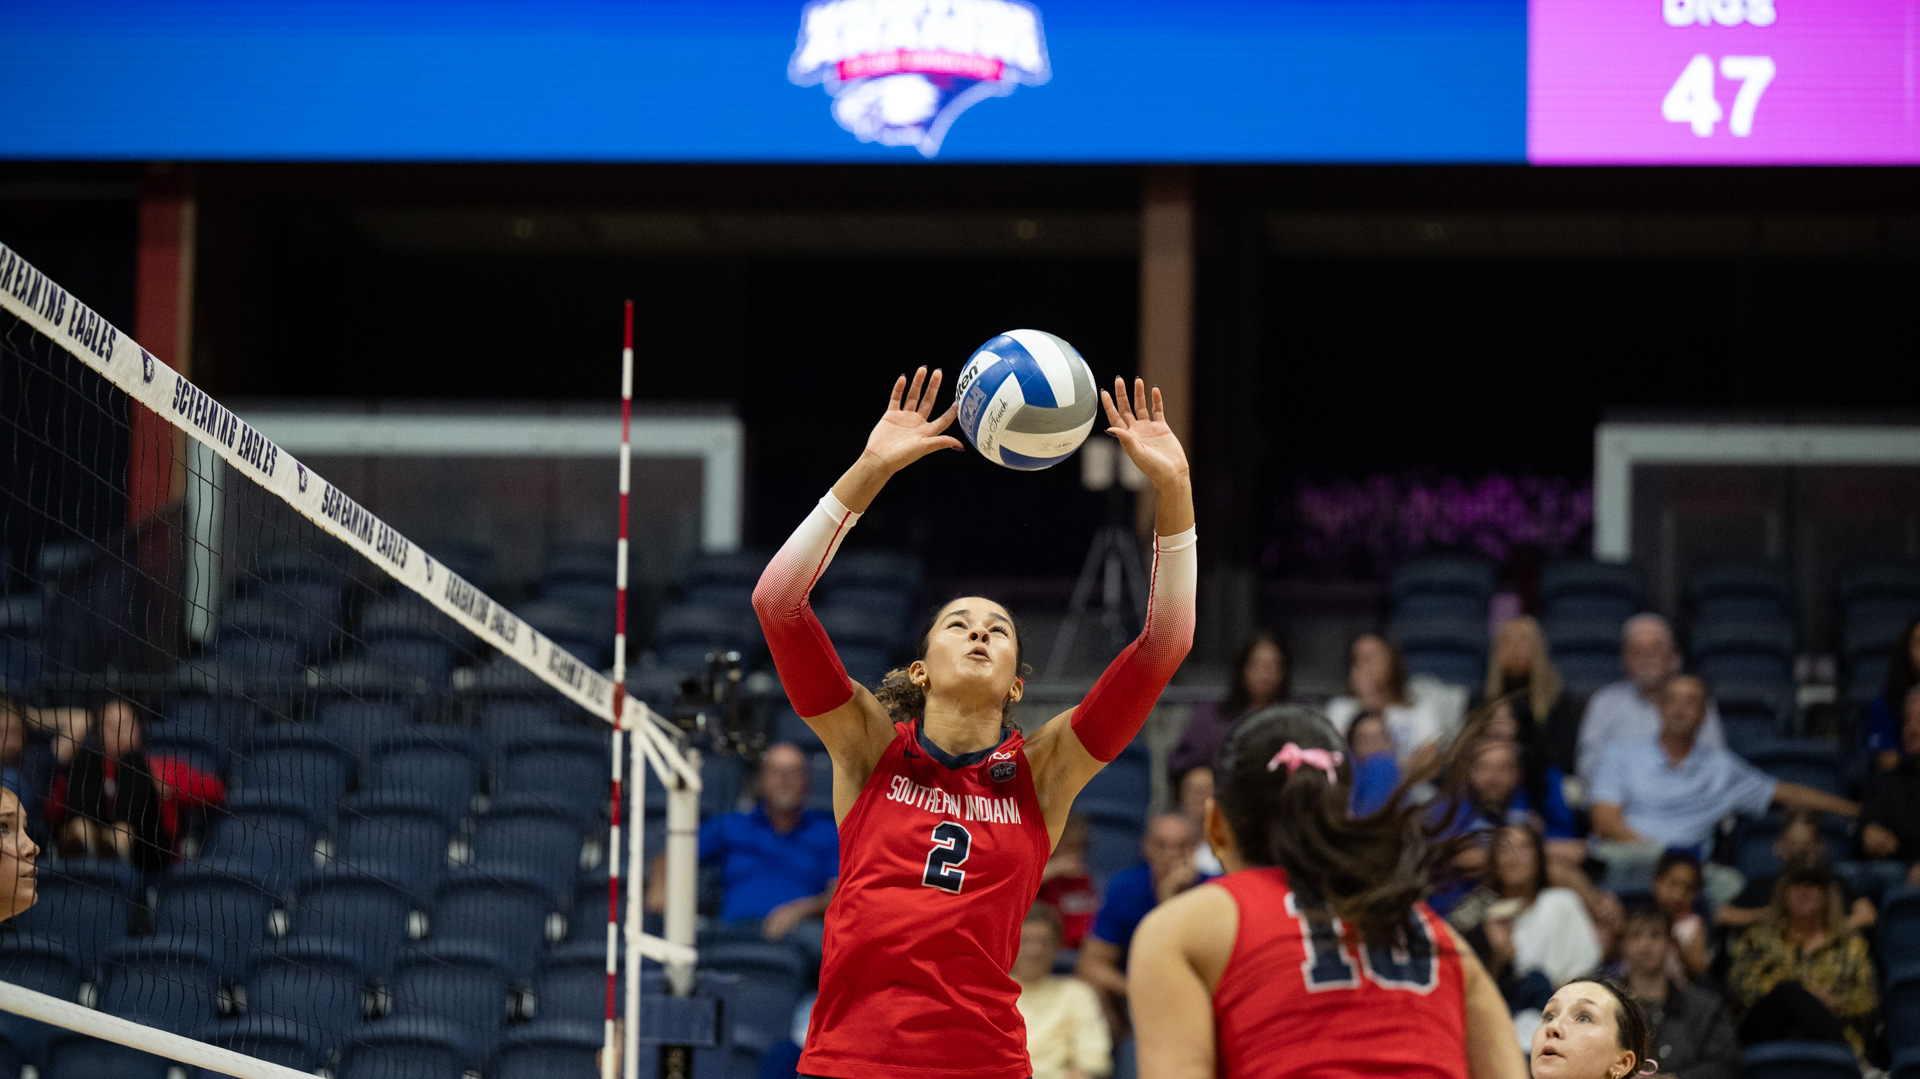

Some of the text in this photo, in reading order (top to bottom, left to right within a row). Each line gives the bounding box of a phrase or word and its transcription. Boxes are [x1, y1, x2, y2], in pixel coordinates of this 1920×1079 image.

[1661, 53, 1777, 137] 47
[68, 299, 117, 363] EAGLES
[172, 375, 278, 477] SCREAMING EAGLES
[987, 398, 1008, 432] Touch
[321, 483, 375, 547] SCREAMING
[886, 775, 1022, 825] SOUTHERN INDIANA
[993, 767, 1013, 778] OVC
[921, 820, 972, 895] 2
